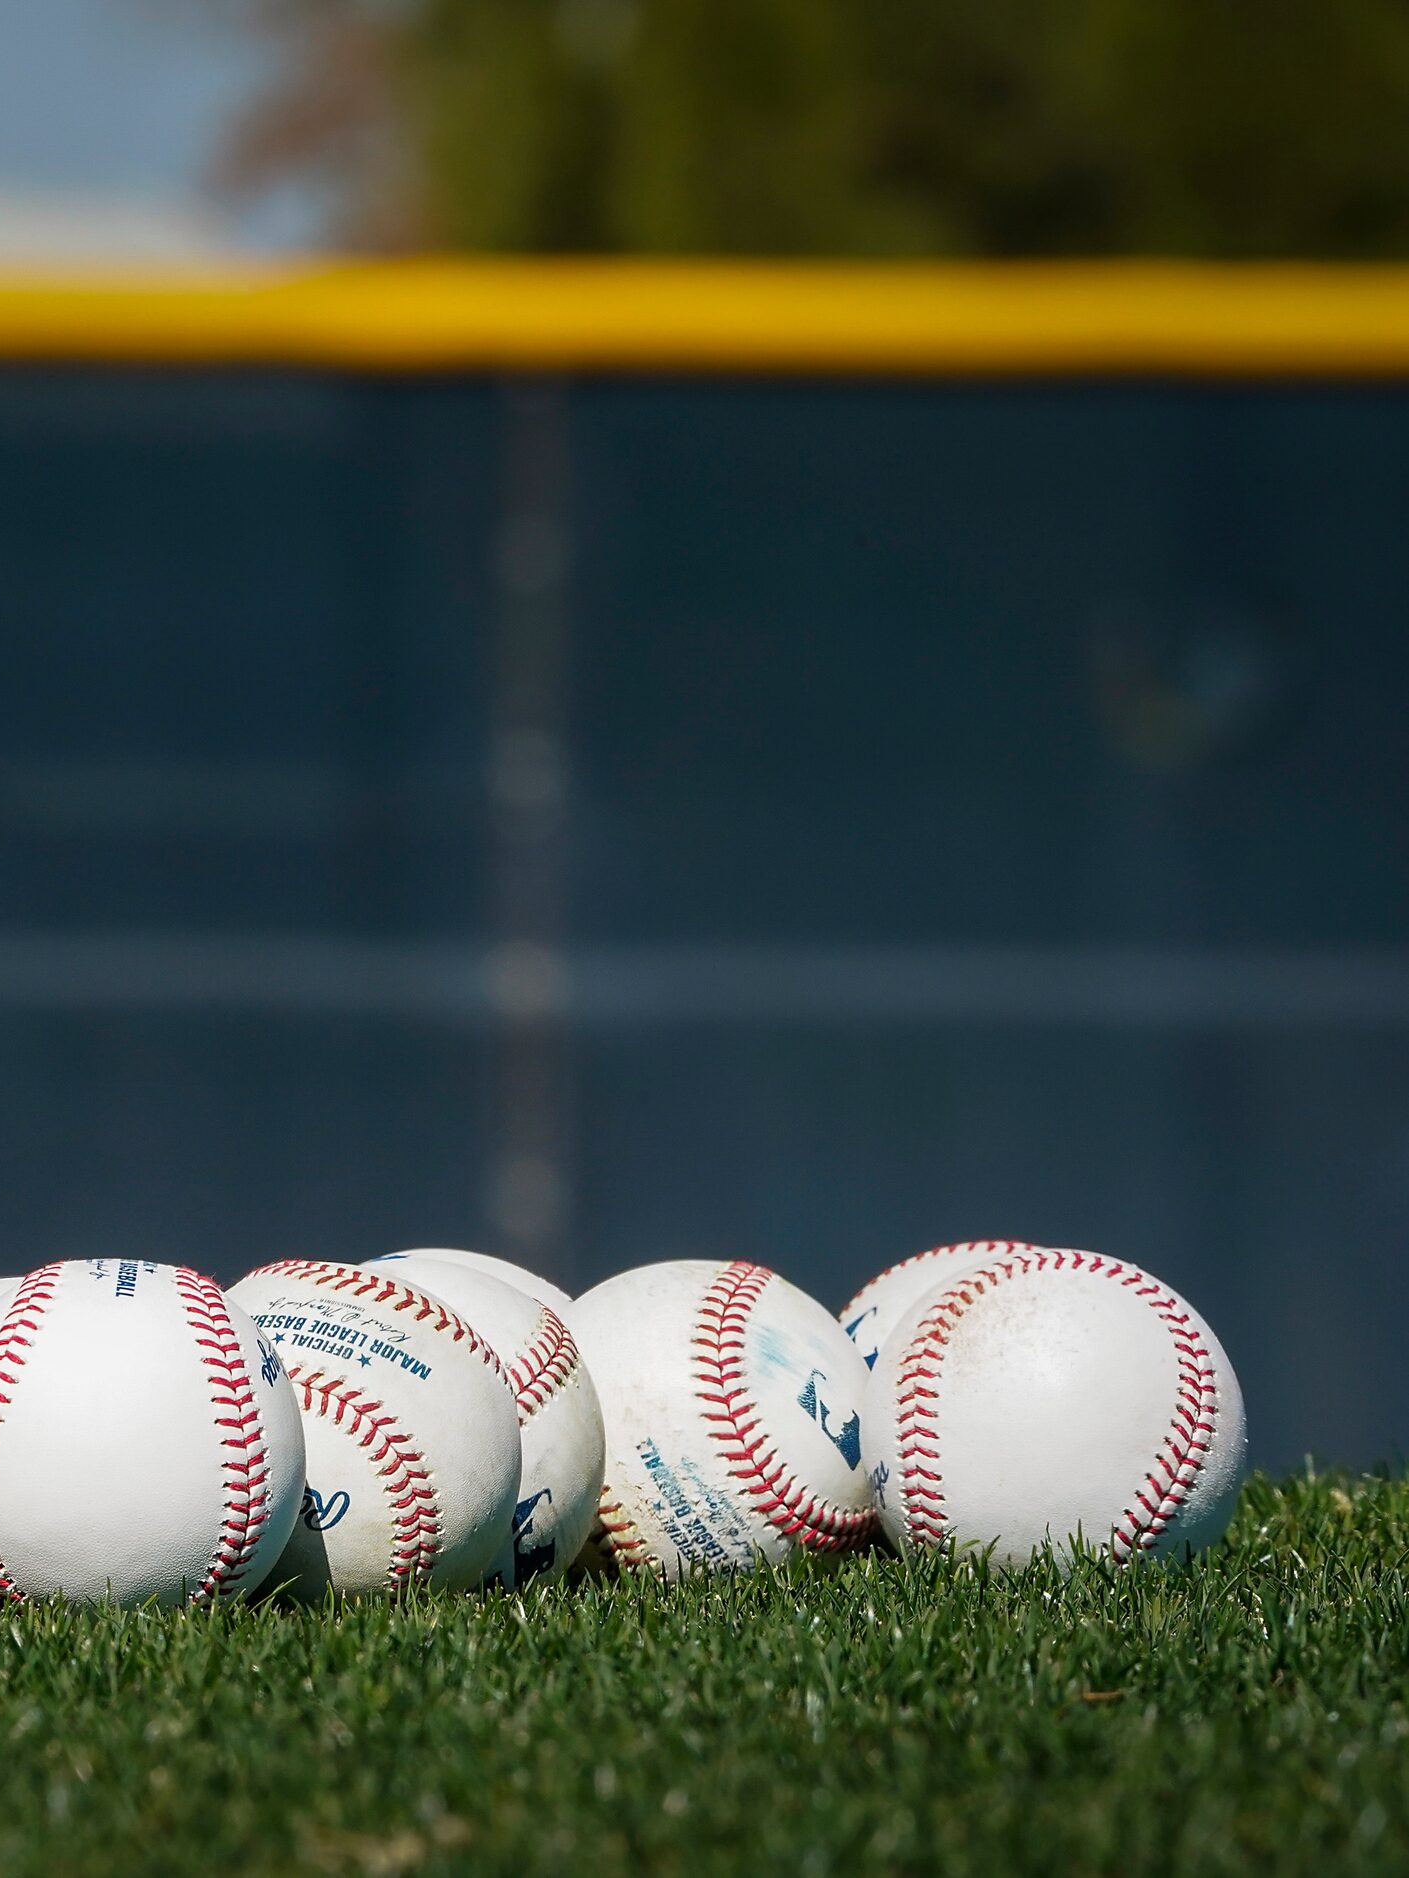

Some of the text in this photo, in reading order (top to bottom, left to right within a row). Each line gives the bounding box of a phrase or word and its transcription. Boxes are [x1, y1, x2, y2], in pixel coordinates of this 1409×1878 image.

[292, 1333, 354, 1360] OFFICIAL
[308, 1319, 369, 1348] LEAGUE
[369, 1338, 433, 1381] MAJOR
